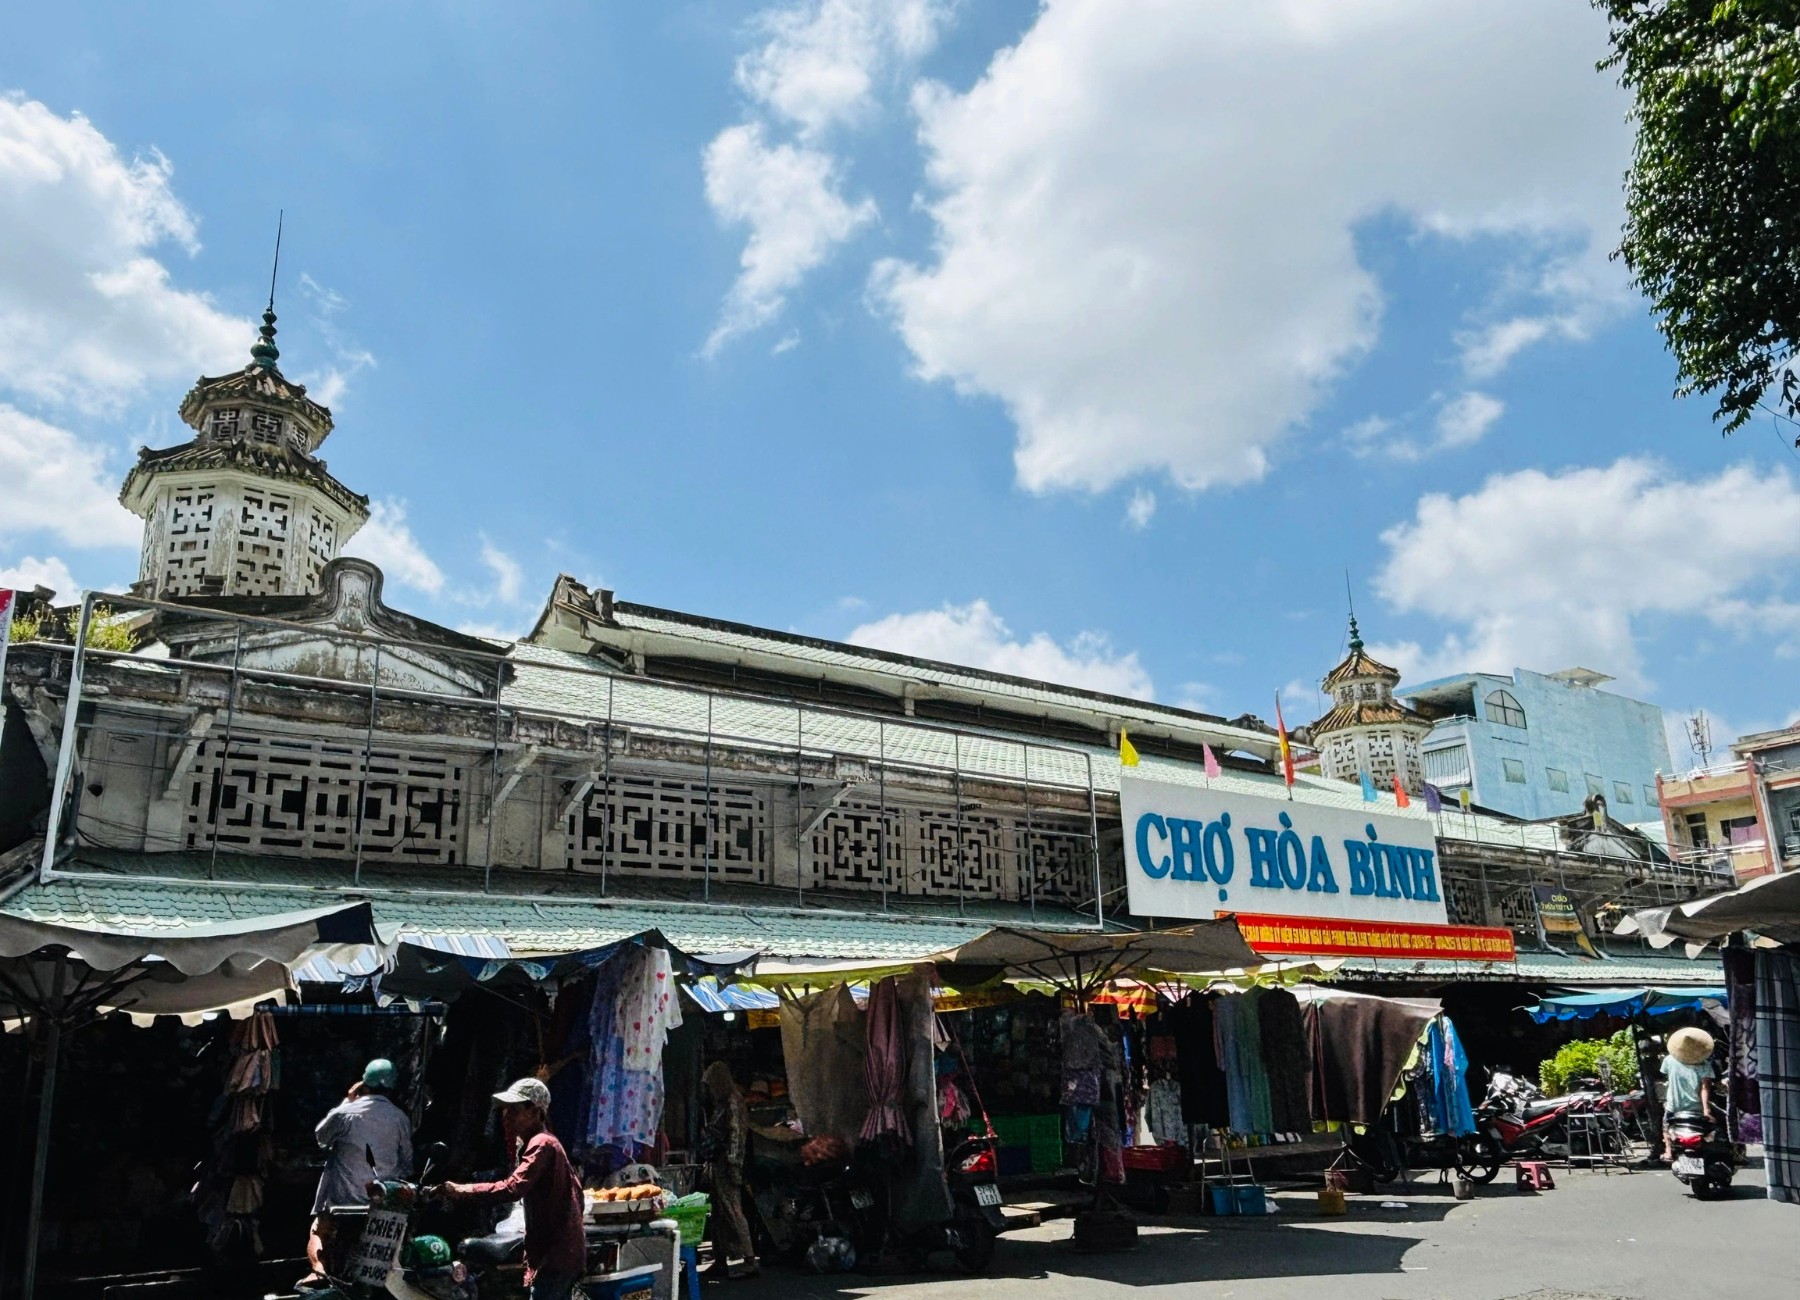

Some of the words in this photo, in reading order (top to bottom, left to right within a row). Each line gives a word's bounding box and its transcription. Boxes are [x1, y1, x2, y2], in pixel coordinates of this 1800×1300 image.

[1135, 811, 1235, 902] CHỢ
[1244, 811, 1340, 894] HÒA
[1343, 823, 1441, 902] BÌNH
